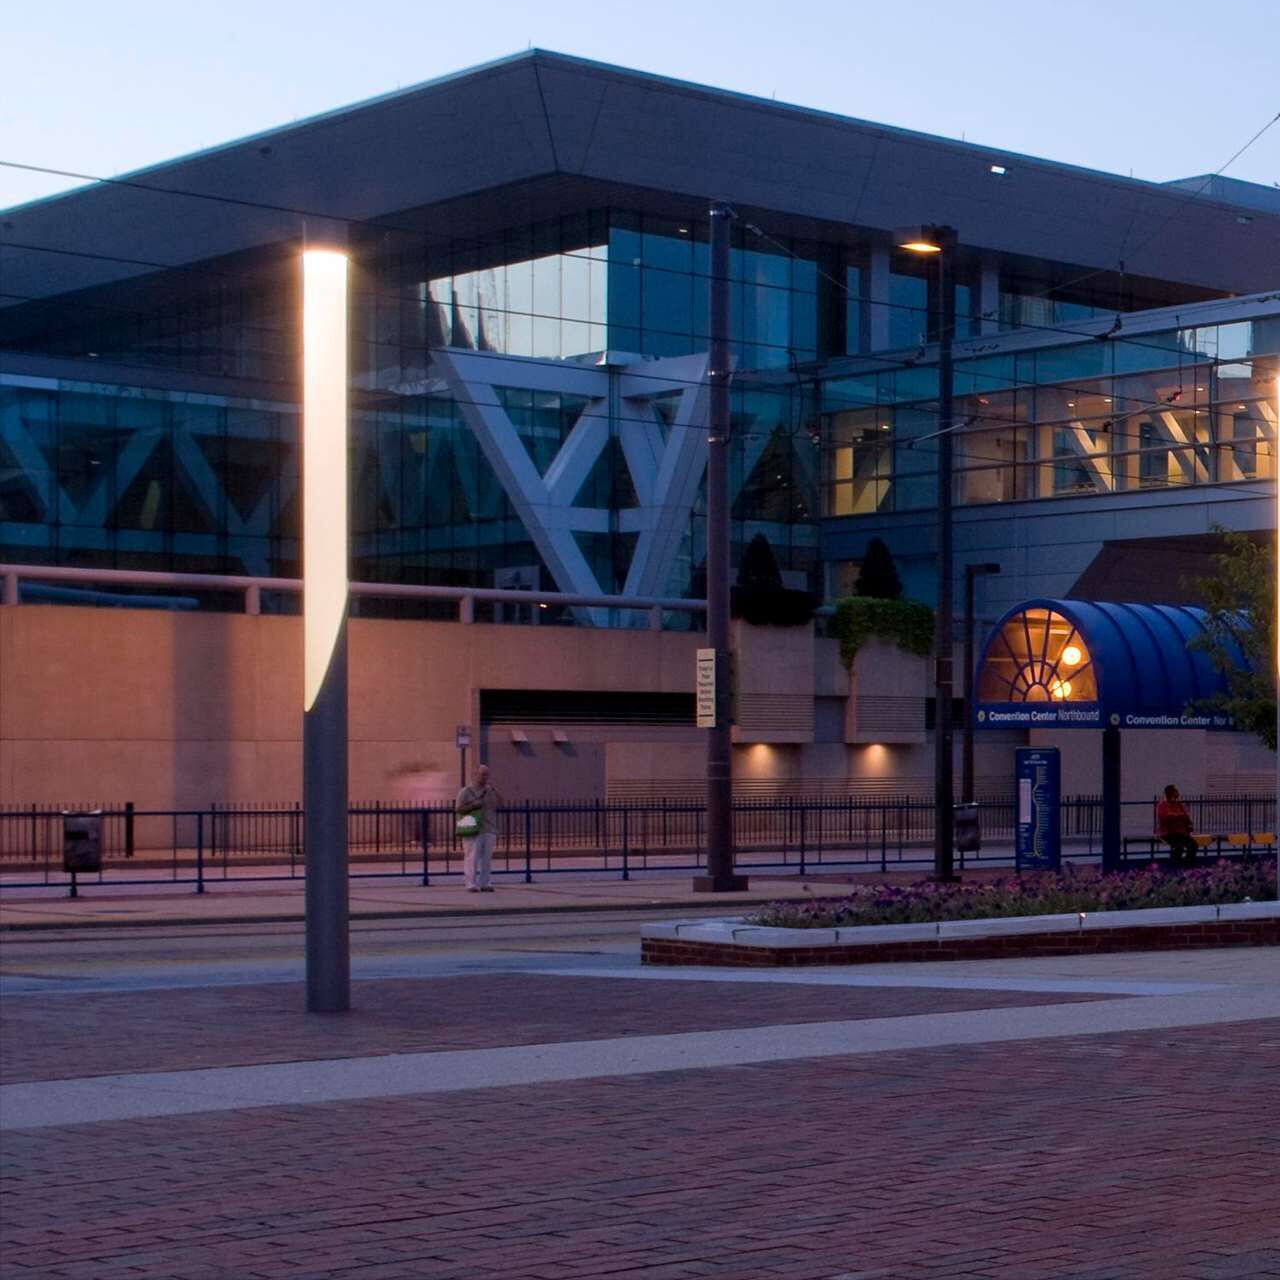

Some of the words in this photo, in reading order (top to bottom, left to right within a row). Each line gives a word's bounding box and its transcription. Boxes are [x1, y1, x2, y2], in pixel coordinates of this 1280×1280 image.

[989, 711, 1030, 721] Convention
[1031, 711, 1057, 721] Center
[1058, 709, 1101, 721] Northbound
[1126, 715, 1179, 726] Convention
[1180, 716, 1211, 726] Center
